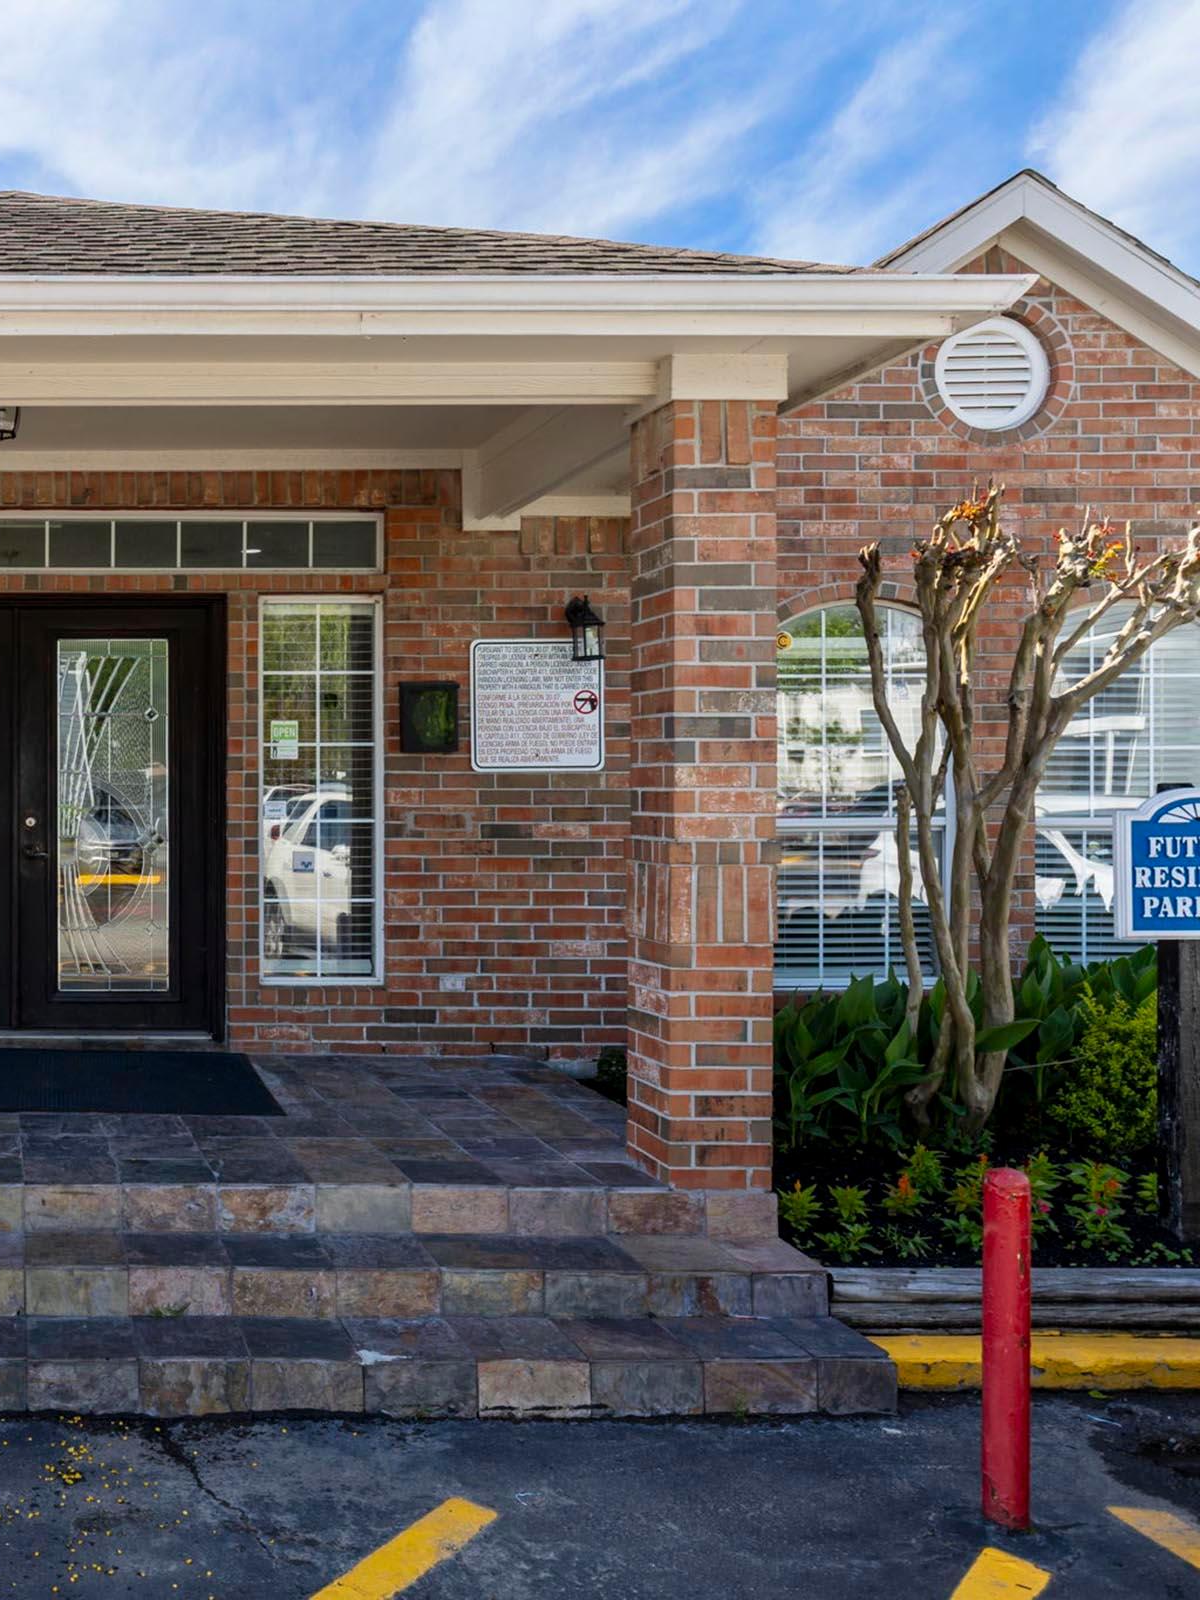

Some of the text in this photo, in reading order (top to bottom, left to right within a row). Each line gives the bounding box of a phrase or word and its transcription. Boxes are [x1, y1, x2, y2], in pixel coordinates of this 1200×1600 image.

[273, 727, 296, 737] OPEN
[1148, 837, 1200, 858] FUT
[1135, 866, 1200, 888] RESI
[1143, 896, 1200, 918] PAR
